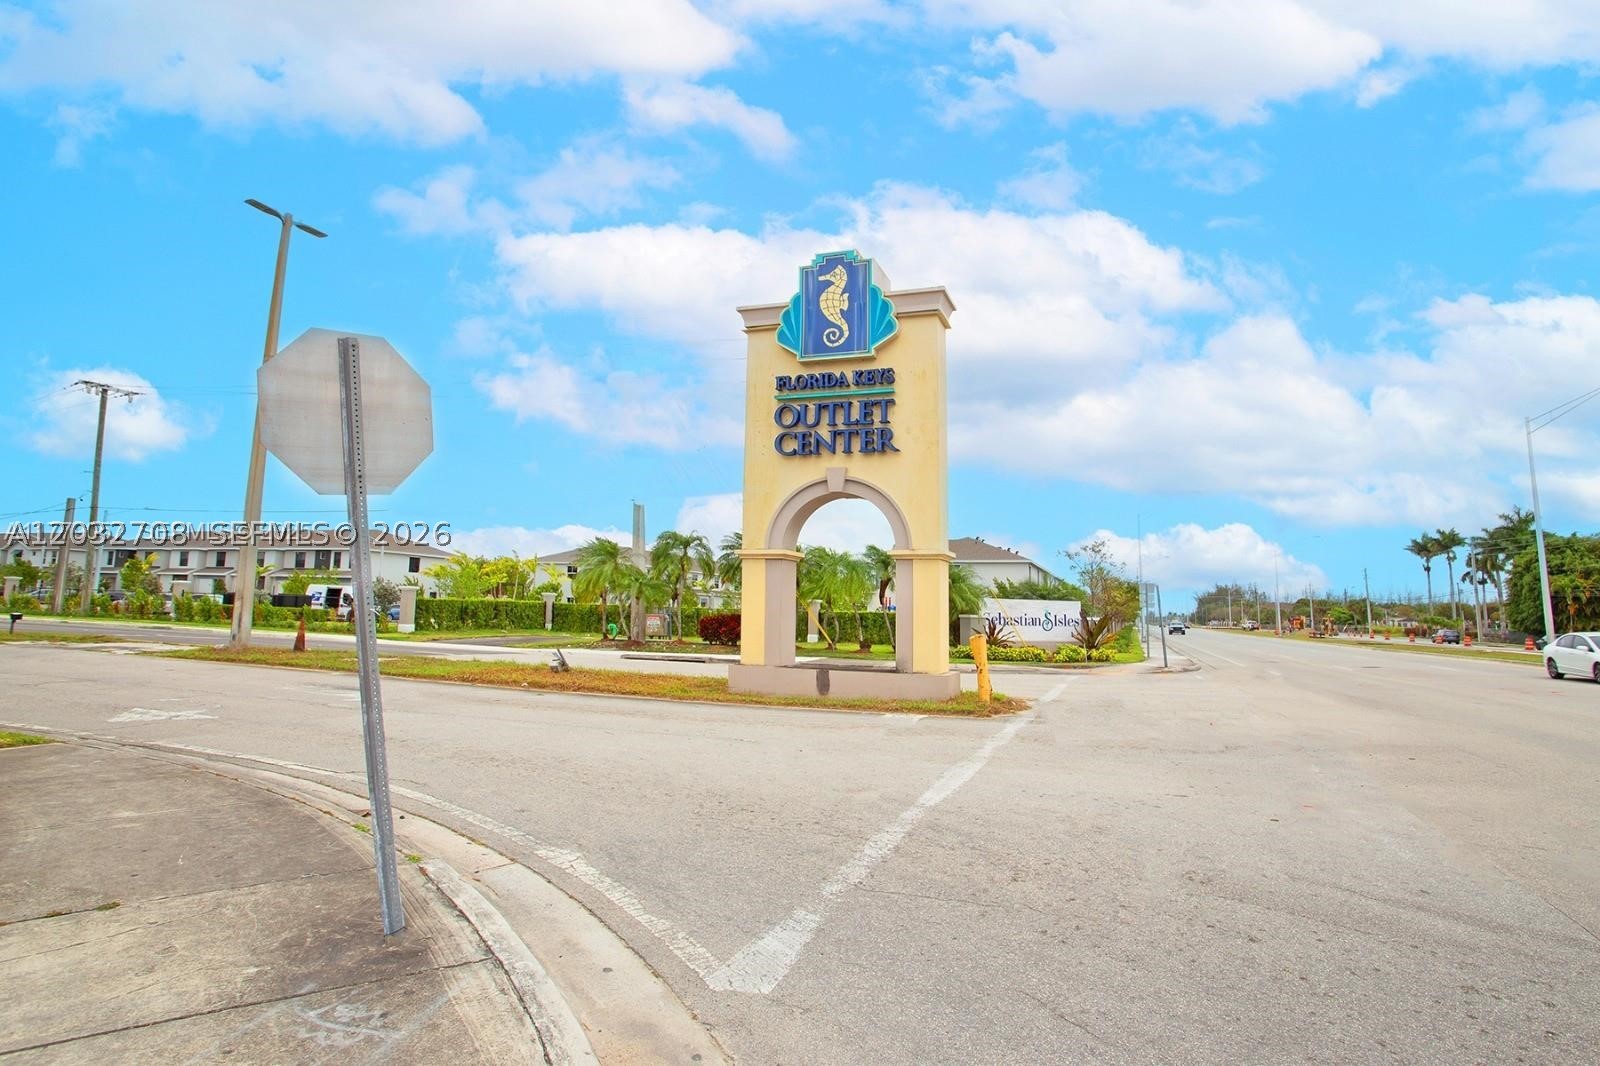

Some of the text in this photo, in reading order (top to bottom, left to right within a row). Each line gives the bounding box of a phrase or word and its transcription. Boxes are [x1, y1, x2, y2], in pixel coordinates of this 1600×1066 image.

[775, 368, 896, 391] FLORIDA KEYS
[774, 398, 896, 428] OUTLET
[774, 427, 900, 456] CENTER
[1054, 613, 1080, 627] Isles
